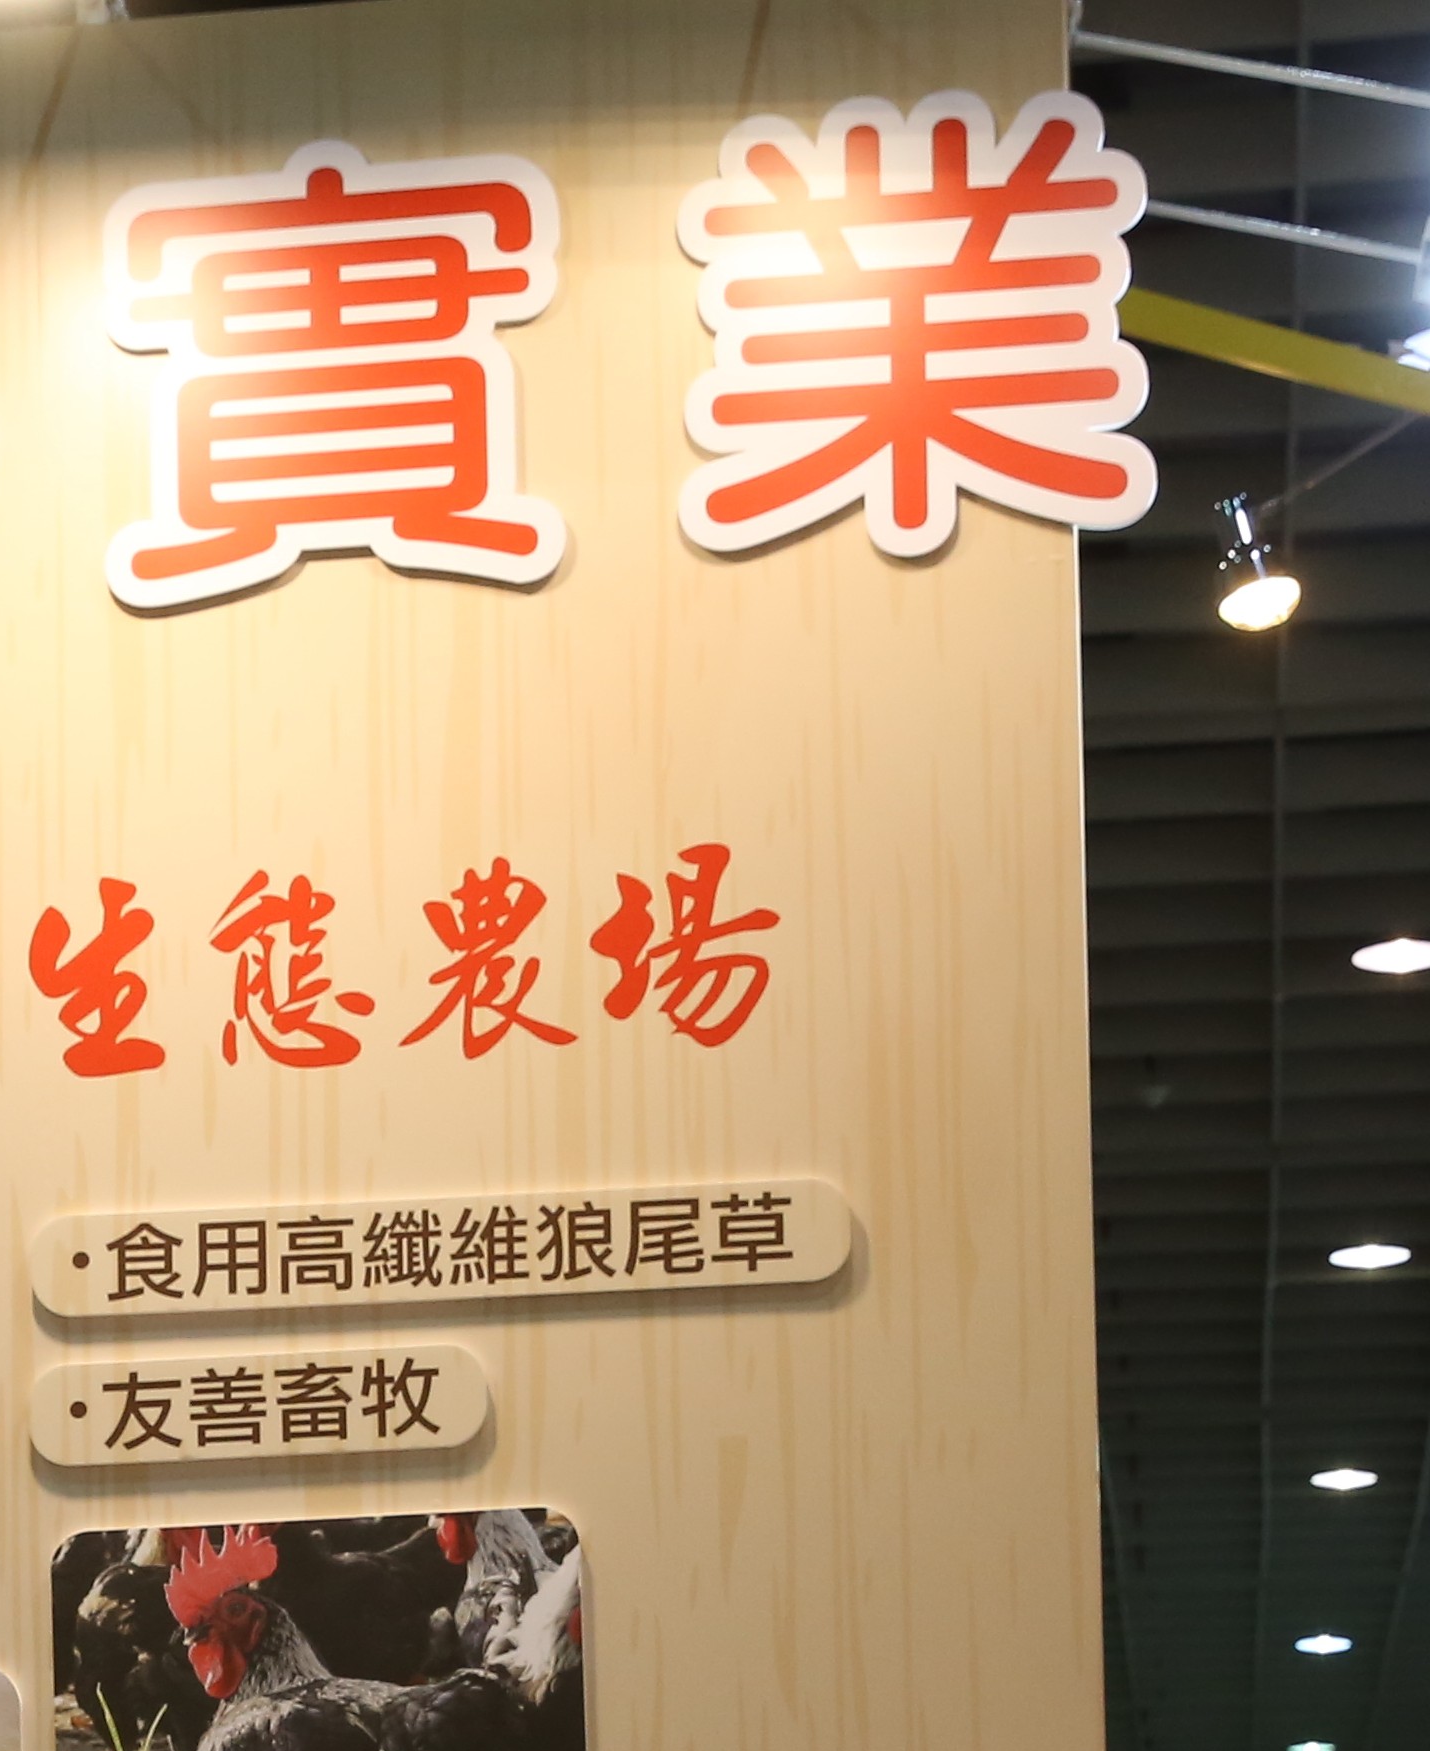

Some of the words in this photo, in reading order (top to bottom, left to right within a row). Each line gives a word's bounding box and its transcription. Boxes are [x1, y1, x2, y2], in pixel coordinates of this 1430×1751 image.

[104, 1193, 795, 1304] 食用高纖維狼尾草
[100, 1356, 442, 1452] 友善畜牧
